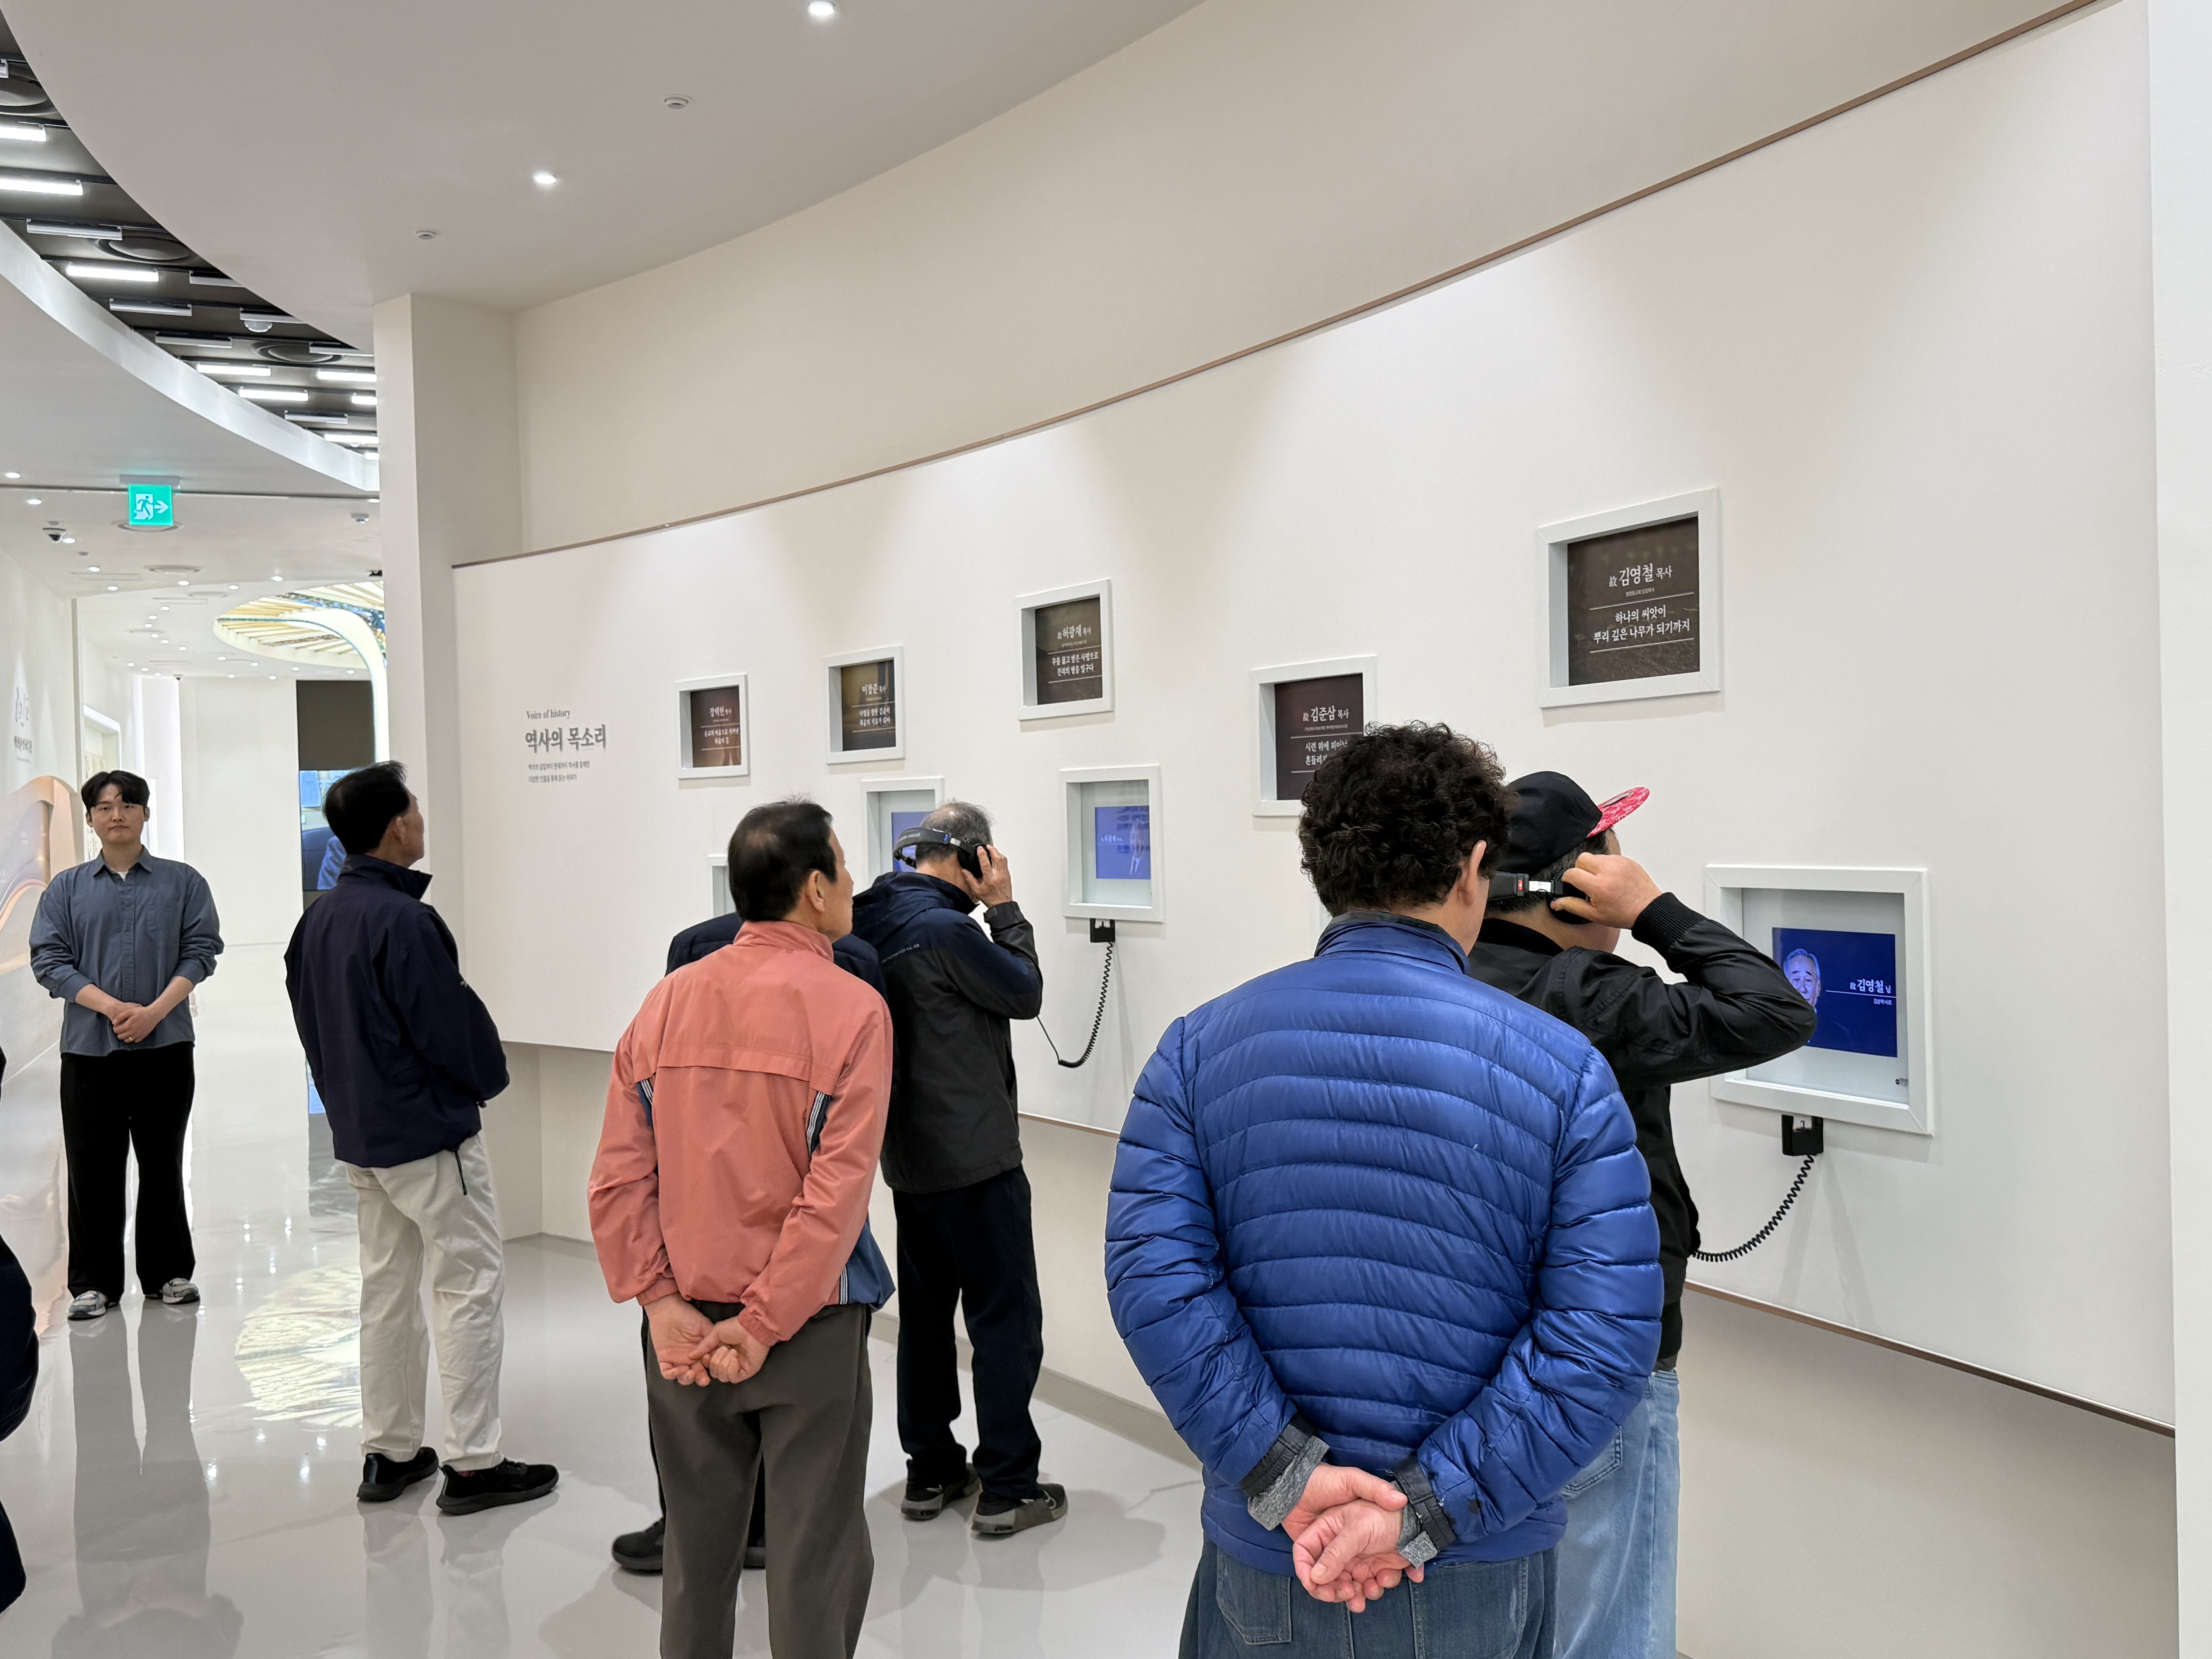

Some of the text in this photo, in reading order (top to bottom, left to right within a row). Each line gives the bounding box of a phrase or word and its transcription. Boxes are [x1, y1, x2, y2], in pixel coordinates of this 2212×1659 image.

[1619, 563, 1654, 587] 김영철
[1656, 565, 1673, 579] 목사
[1615, 605, 1666, 624] 하나의 씨앗이
[1062, 624, 1082, 639] 허광재
[1083, 627, 1091, 636] 목사
[1594, 618, 1690, 644] 뿌리 깊은 나무가 되기까지
[1081, 652, 1099, 662] 사명으로
[527, 709, 570, 720] Voice of history
[1310, 705, 1336, 722] 김준삼
[1337, 709, 1350, 719] 목사
[526, 724, 606, 754] 역사의 목소리
[1305, 741, 1316, 752] 시련
[1317, 741, 1329, 751] 위에
[1857, 979, 1884, 993] 김영철
[1885, 985, 1891, 994] 님
